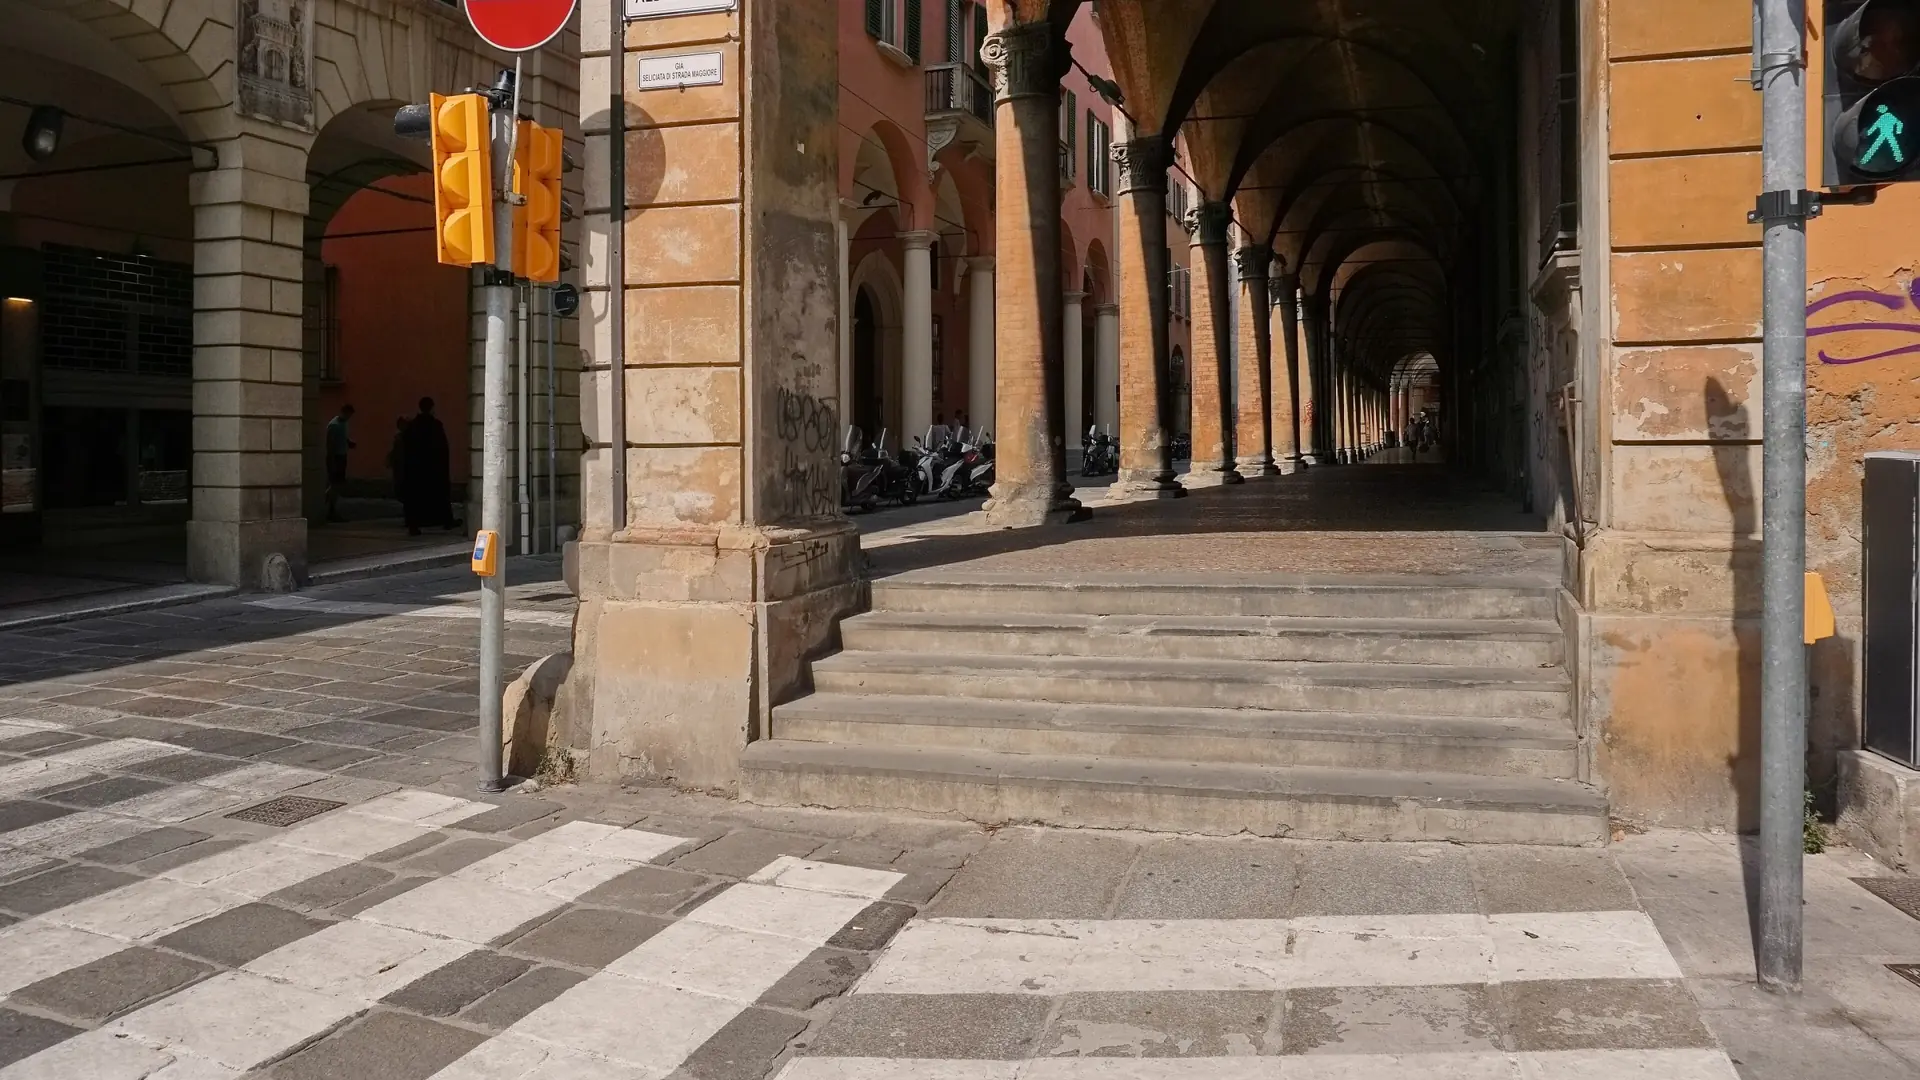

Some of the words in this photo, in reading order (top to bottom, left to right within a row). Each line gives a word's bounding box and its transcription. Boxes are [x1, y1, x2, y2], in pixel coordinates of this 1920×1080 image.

[642, 72, 665, 82] SELICIATA
[666, 72, 672, 80] DI
[672, 69, 691, 79] STRADA
[691, 68, 717, 78] MAGGIORE
